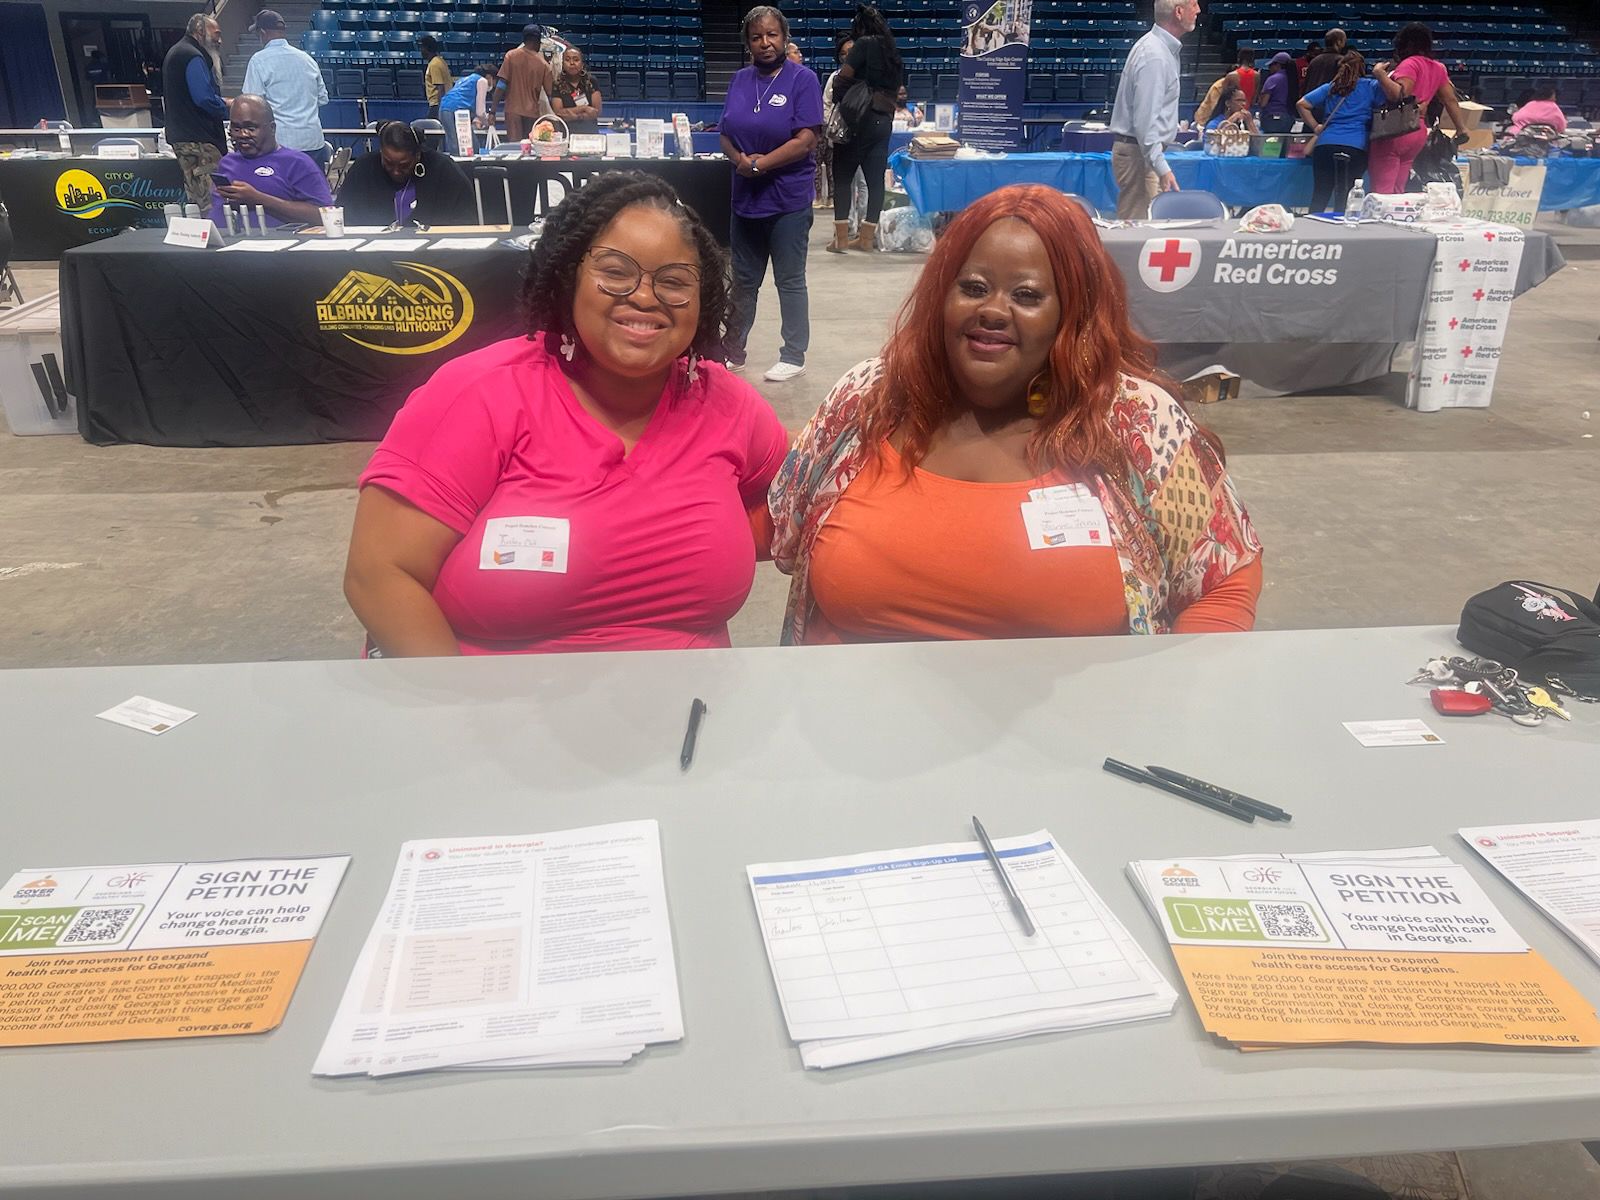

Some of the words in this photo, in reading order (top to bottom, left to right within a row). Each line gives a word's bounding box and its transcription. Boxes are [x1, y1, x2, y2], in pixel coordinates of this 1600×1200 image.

[108, 177, 188, 203] Albany
[1501, 186, 1532, 198] Closet
[1218, 238, 1343, 259] American
[1213, 263, 1262, 284] Red
[1266, 263, 1338, 285] Cross
[316, 305, 377, 321] ALBANY
[382, 305, 454, 321] HOUSING
[396, 321, 454, 332] AUTHORITY
[196, 870, 262, 884] SIGN
[268, 868, 319, 881] THE
[1329, 874, 1394, 888] SIGN
[1396, 876, 1453, 889] THE
[186, 883, 308, 900] PETITION
[1337, 889, 1462, 904] PETITION
[167, 911, 202, 920] Your
[204, 908, 244, 918] voice
[276, 904, 311, 914] help
[1202, 906, 1249, 916] SCAN
[1342, 912, 1383, 922] Your
[1384, 914, 1422, 923] voice
[1453, 915, 1489, 925] help
[21, 915, 72, 926] SCAN
[159, 919, 216, 930] change
[219, 917, 269, 926] health
[1208, 917, 1258, 933] ME!
[1350, 922, 1406, 934] change
[1410, 923, 1459, 933] health
[1462, 926, 1497, 934] care
[8, 926, 61, 942] ME!
[204, 926, 268, 936] Georgia.
[1405, 933, 1472, 944] Georgia.
[76, 955, 144, 965] movement
[161, 952, 209, 961] expand
[1261, 952, 1285, 960] Join
[1310, 954, 1375, 963] movement
[1393, 956, 1439, 965] expand
[6, 969, 48, 977] health
[148, 961, 215, 970] Georgians.
[1252, 961, 1292, 969] health
[1391, 965, 1459, 974] Georgians.
[47, 980, 106, 989] Georgians
[135, 975, 190, 984] currently
[194, 972, 242, 982] trapped
[107, 985, 156, 993] inaction
[173, 982, 218, 991] expand
[220, 978, 275, 987] Medicaid.
[1192, 972, 1222, 980] More
[1255, 975, 1304, 984] 200,000
[1308, 977, 1368, 986] Georgians
[1396, 980, 1450, 988] currently
[1455, 981, 1500, 990] trapped
[1195, 980, 1249, 990] coverage
[1379, 986, 1426, 994] inaction
[1444, 988, 1487, 996] expand
[1489, 989, 1547, 997] Medicaid.
[1198, 987, 1223, 996] Sign
[1253, 990, 1288, 999] online
[1293, 992, 1338, 1000] petition
[1417, 994, 1506, 1005] Comprehensive
[1511, 996, 1554, 1005] Health
[8, 999, 55, 1007] petition
[136, 988, 228, 1000] Comprehensive
[232, 986, 273, 994] Health
[75, 1003, 118, 1012] closing
[186, 996, 241, 1005] coverage
[245, 994, 269, 1002] gap
[1201, 995, 1258, 1005] Coverage
[1261, 999, 1334, 1008] Commission
[1367, 1002, 1412, 1011] closing
[1477, 1004, 1532, 1013] coverage
[118, 1007, 177, 1017] important
[182, 1005, 213, 1014] thing
[216, 1002, 265, 1012] Georgia
[1224, 1004, 1285, 1015] expanding
[1288, 1007, 1344, 1016] Medicaid
[1419, 1011, 1479, 1020] important
[1482, 1013, 1515, 1022] thing
[1518, 1014, 1567, 1023] Georgia
[65, 1018, 126, 1028] uninsured
[178, 1021, 253, 1032] coverga.org
[1209, 1011, 1241, 1020] could
[1281, 1015, 1351, 1025] low-income
[1379, 1020, 1440, 1028] uninsured
[1441, 1020, 1507, 1029] Georgians.
[1504, 1033, 1580, 1042] coverga.org
